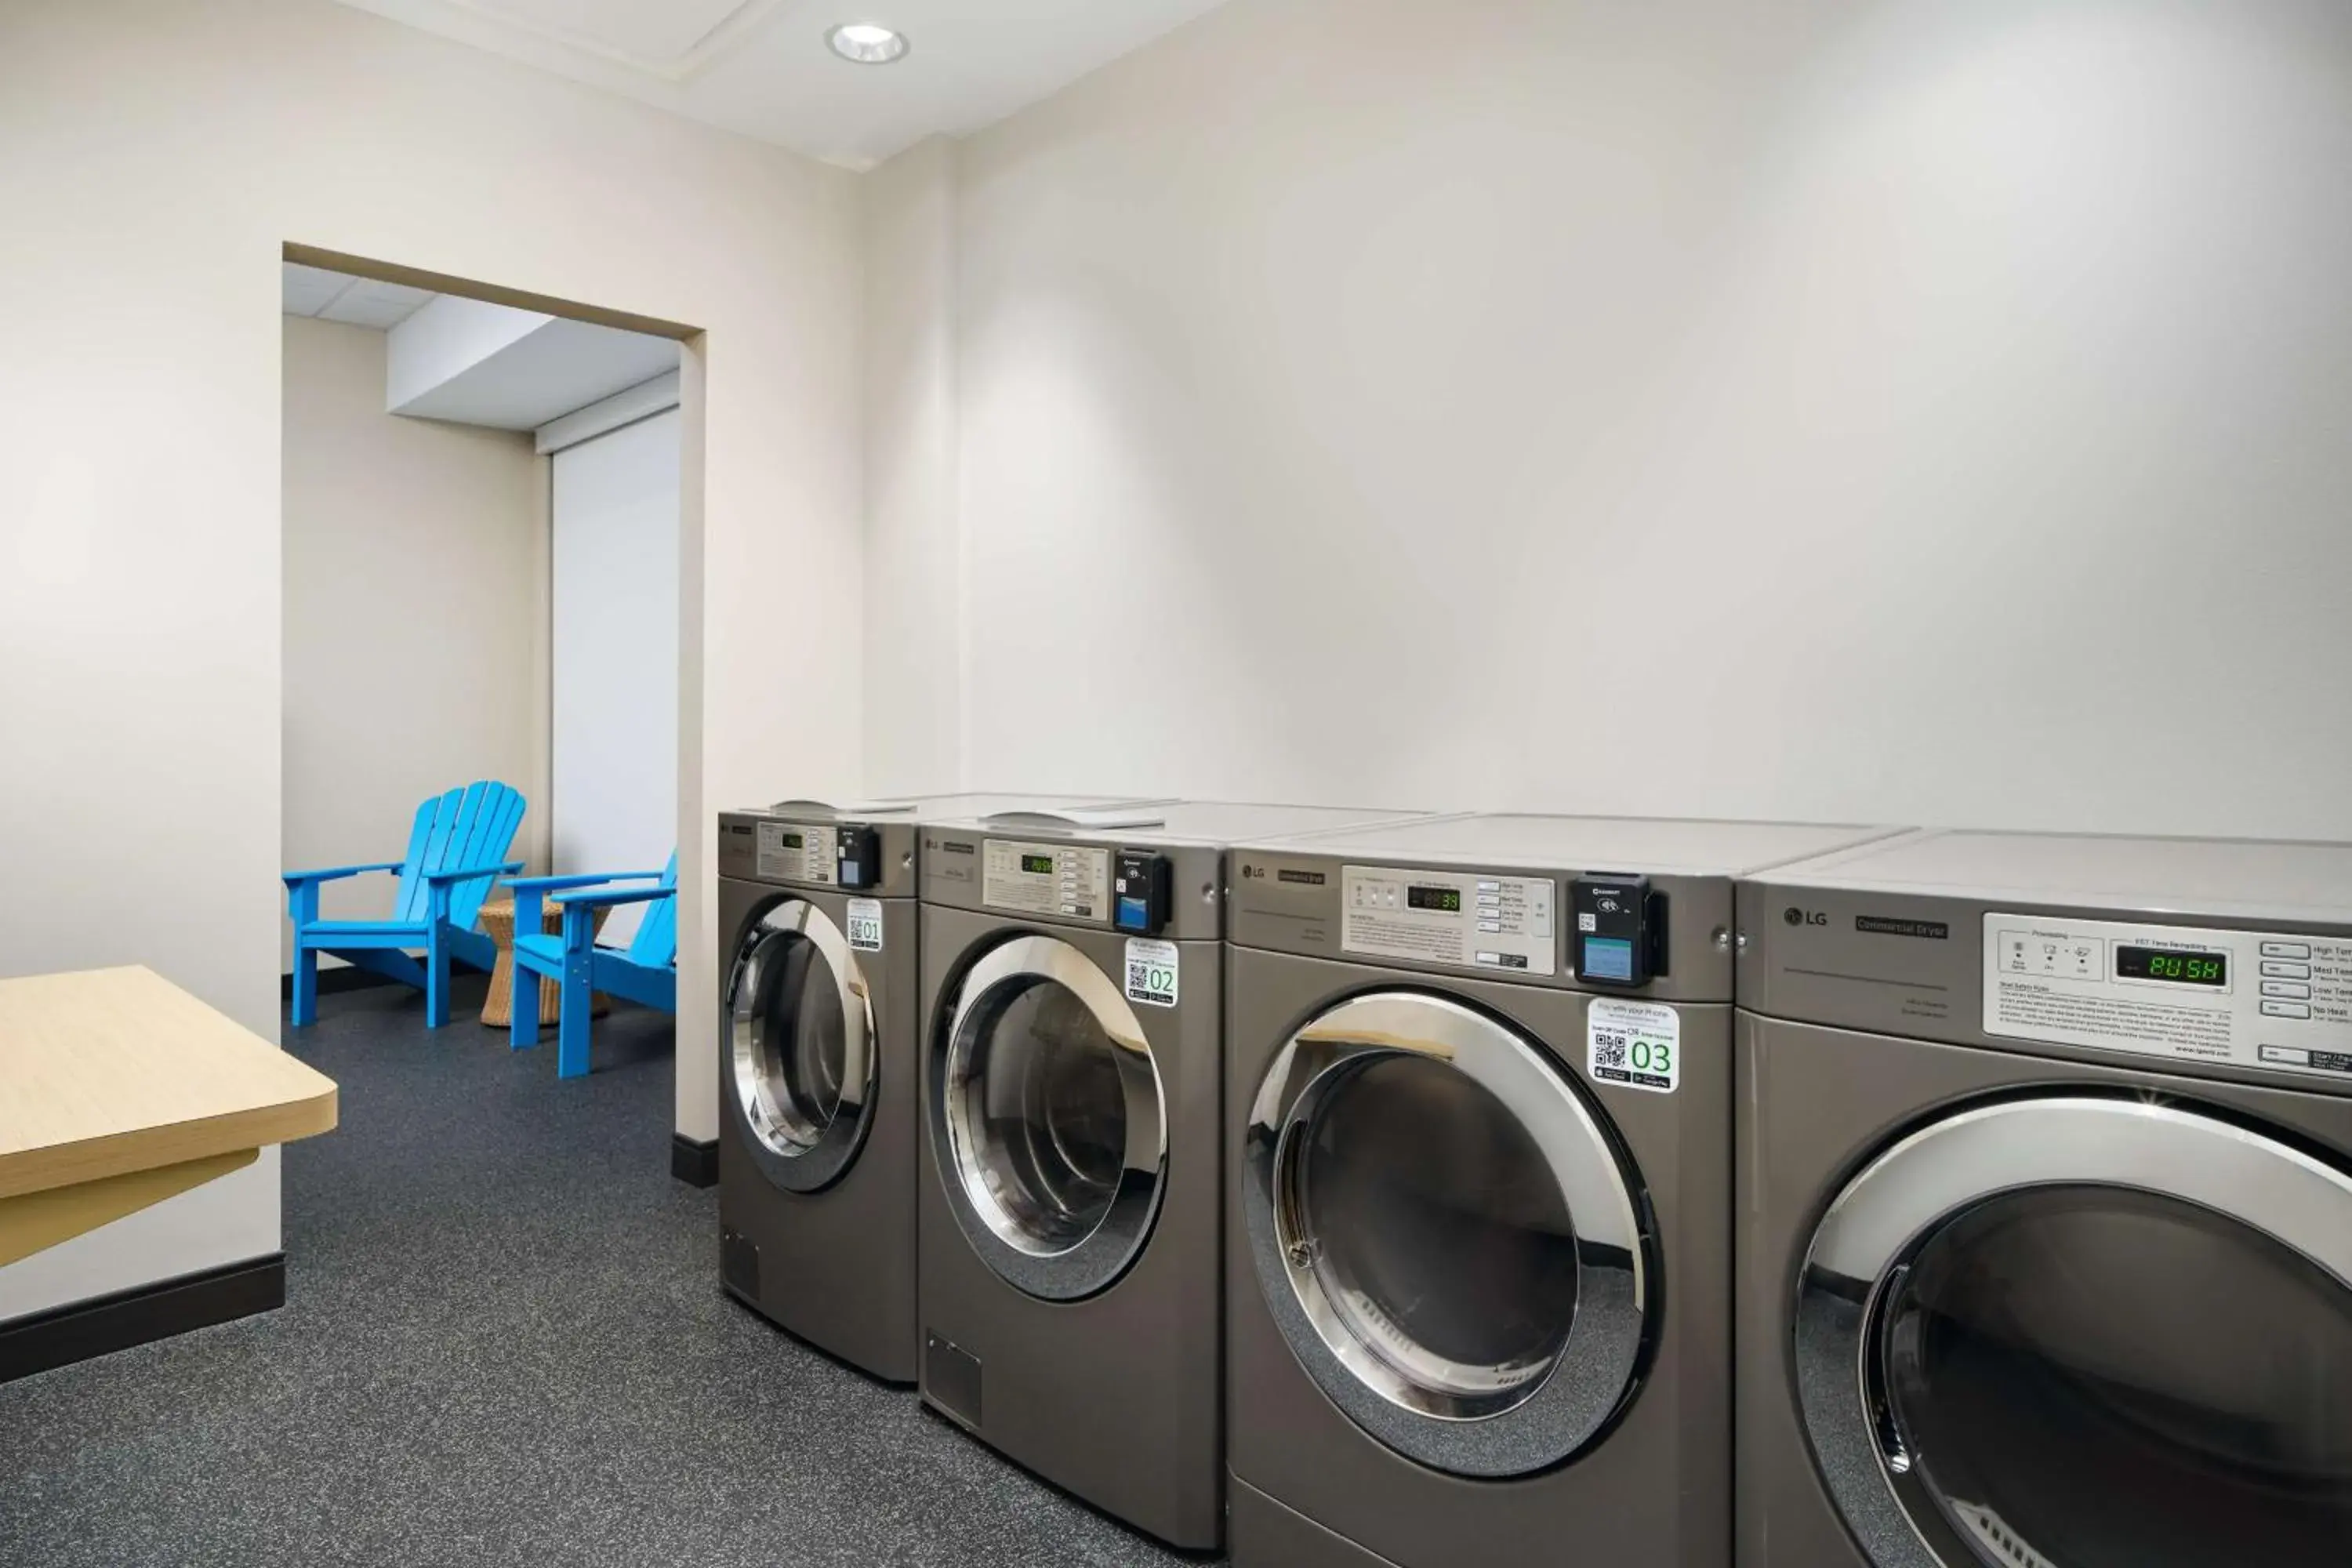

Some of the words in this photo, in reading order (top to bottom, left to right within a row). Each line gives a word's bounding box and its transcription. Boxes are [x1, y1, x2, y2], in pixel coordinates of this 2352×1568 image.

[1253, 866, 1265, 878] LG
[1806, 911, 1828, 926] LG
[1857, 917, 1915, 935] Commercial
[1916, 924, 1947, 938] Dryer
[863, 923, 879, 940] 01
[2150, 956, 2219, 979] PUSH
[1150, 969, 1173, 992] 02
[1632, 1040, 1671, 1072] 03
